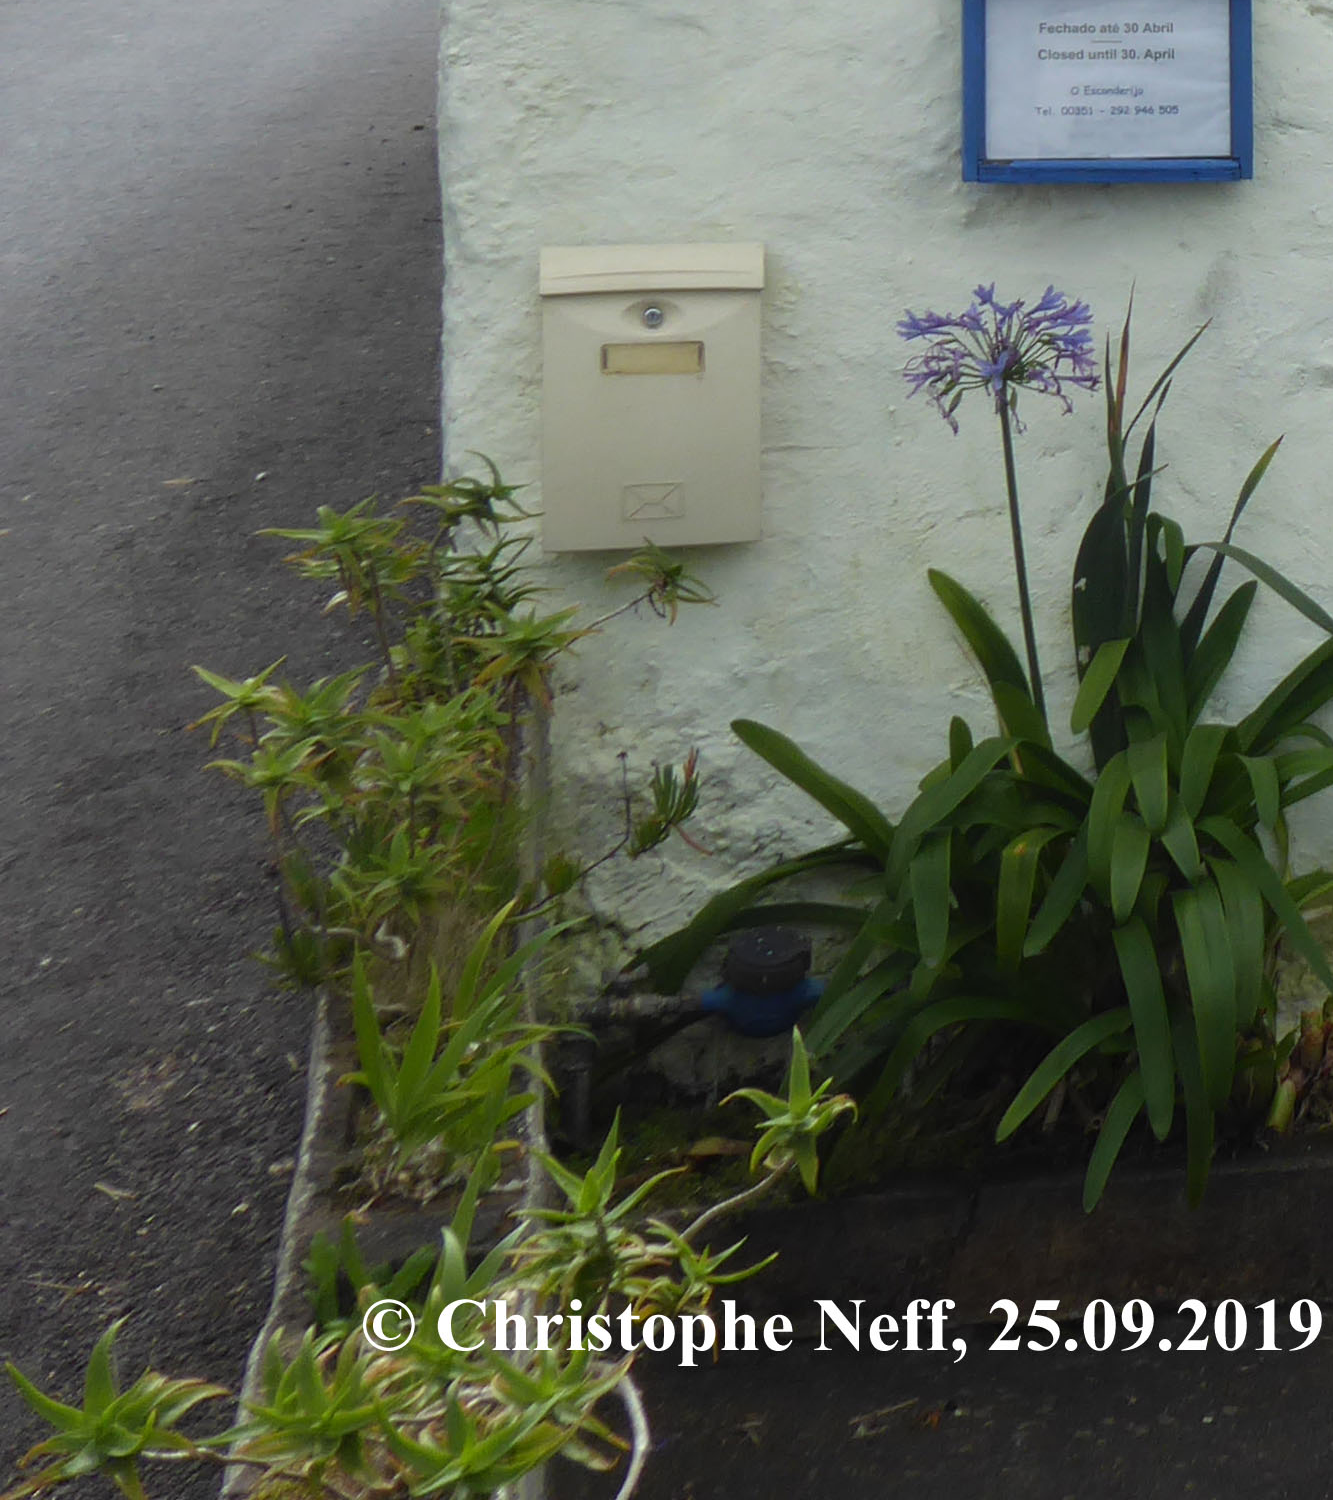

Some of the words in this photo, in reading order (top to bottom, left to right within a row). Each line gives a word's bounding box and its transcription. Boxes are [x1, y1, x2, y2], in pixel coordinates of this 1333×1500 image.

[1038, 21, 1097, 34] Fechado
[1123, 22, 1139, 34] 30
[1142, 21, 1174, 34] Abril
[1038, 48, 1085, 60] Closed
[1088, 48, 1117, 60] until
[1121, 48, 1140, 60] 30.
[1143, 48, 1175, 62] April
[1083, 85, 1144, 98] Esconderijo
[1034, 106, 1056, 116] Tel.
[1061, 105, 1094, 116] 00351
